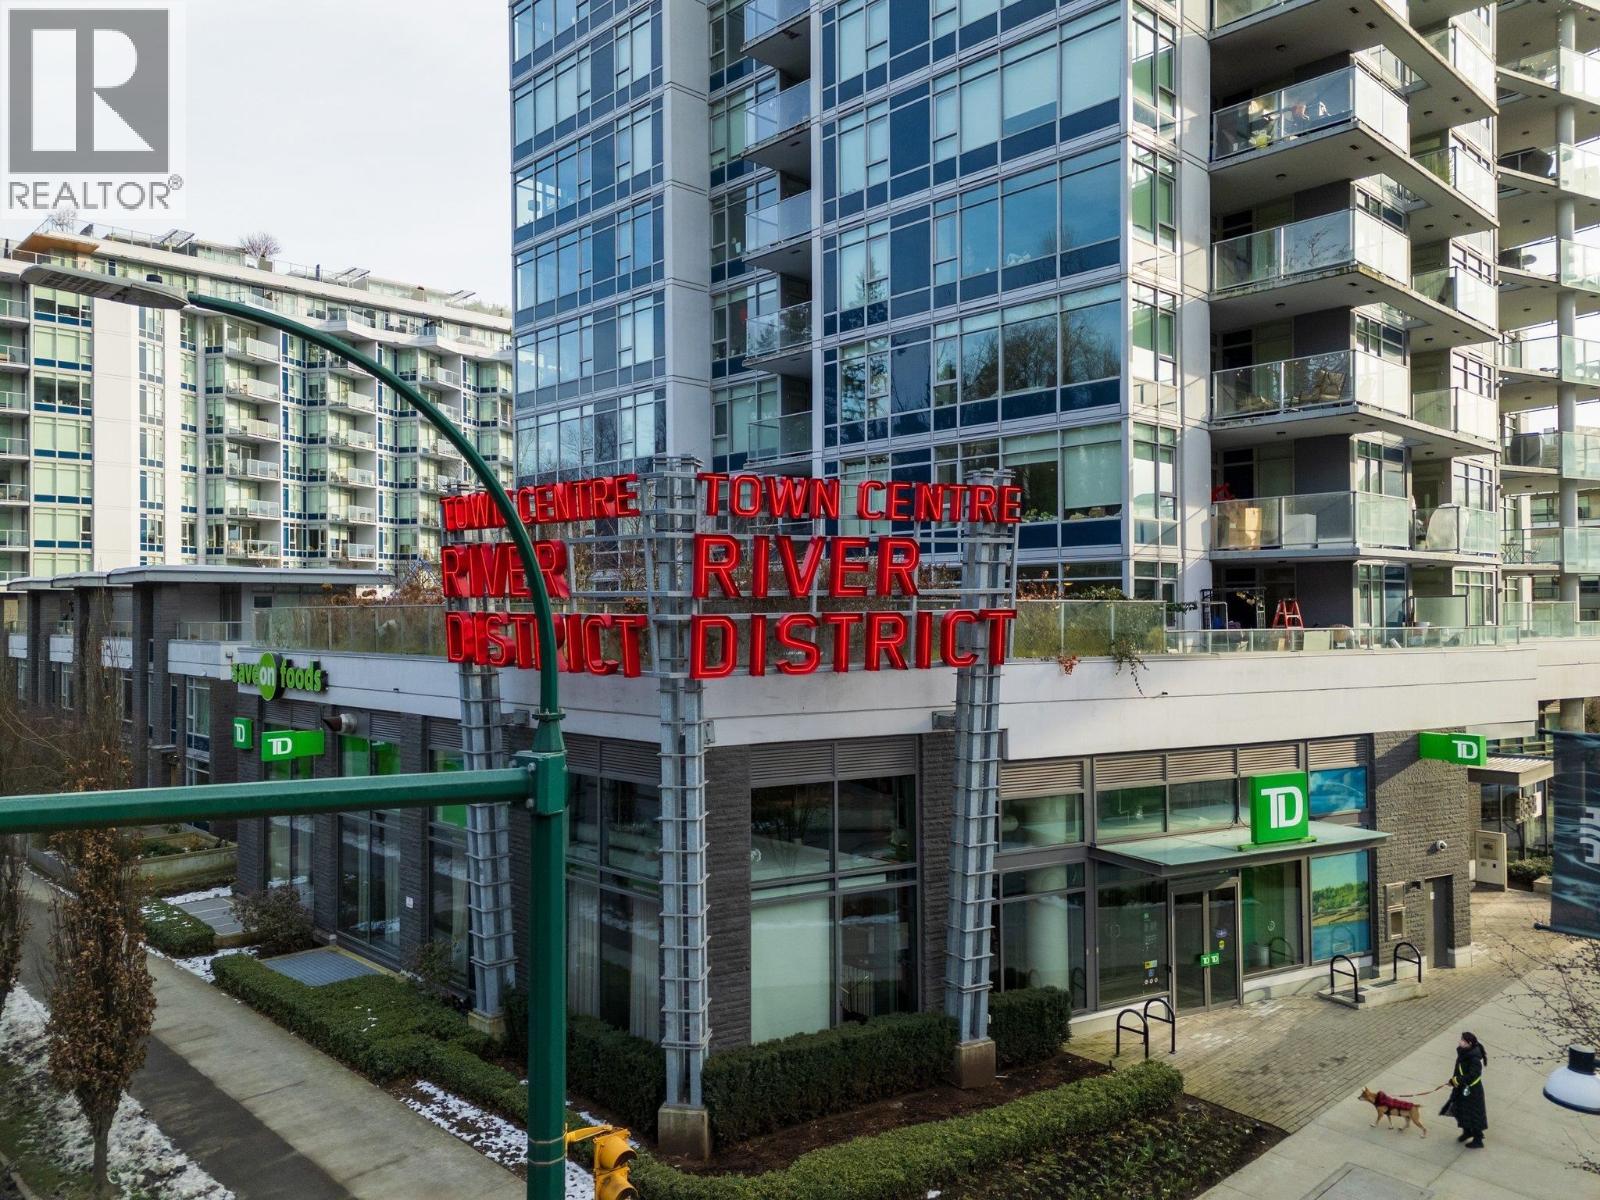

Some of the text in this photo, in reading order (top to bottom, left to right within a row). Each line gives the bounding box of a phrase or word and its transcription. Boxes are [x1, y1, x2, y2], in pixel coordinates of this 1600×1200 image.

[516, 474, 640, 524] CENTRE
[697, 472, 1024, 523] TOWN CENTRE
[441, 539, 571, 600] RIVER
[692, 533, 920, 599] RIVER
[690, 608, 1017, 680] DISTRICT
[280, 658, 321, 692] foods
[234, 723, 245, 743] TD
[267, 737, 293, 755] TD
[1451, 740, 1479, 759] TD
[1260, 786, 1304, 829] TD
